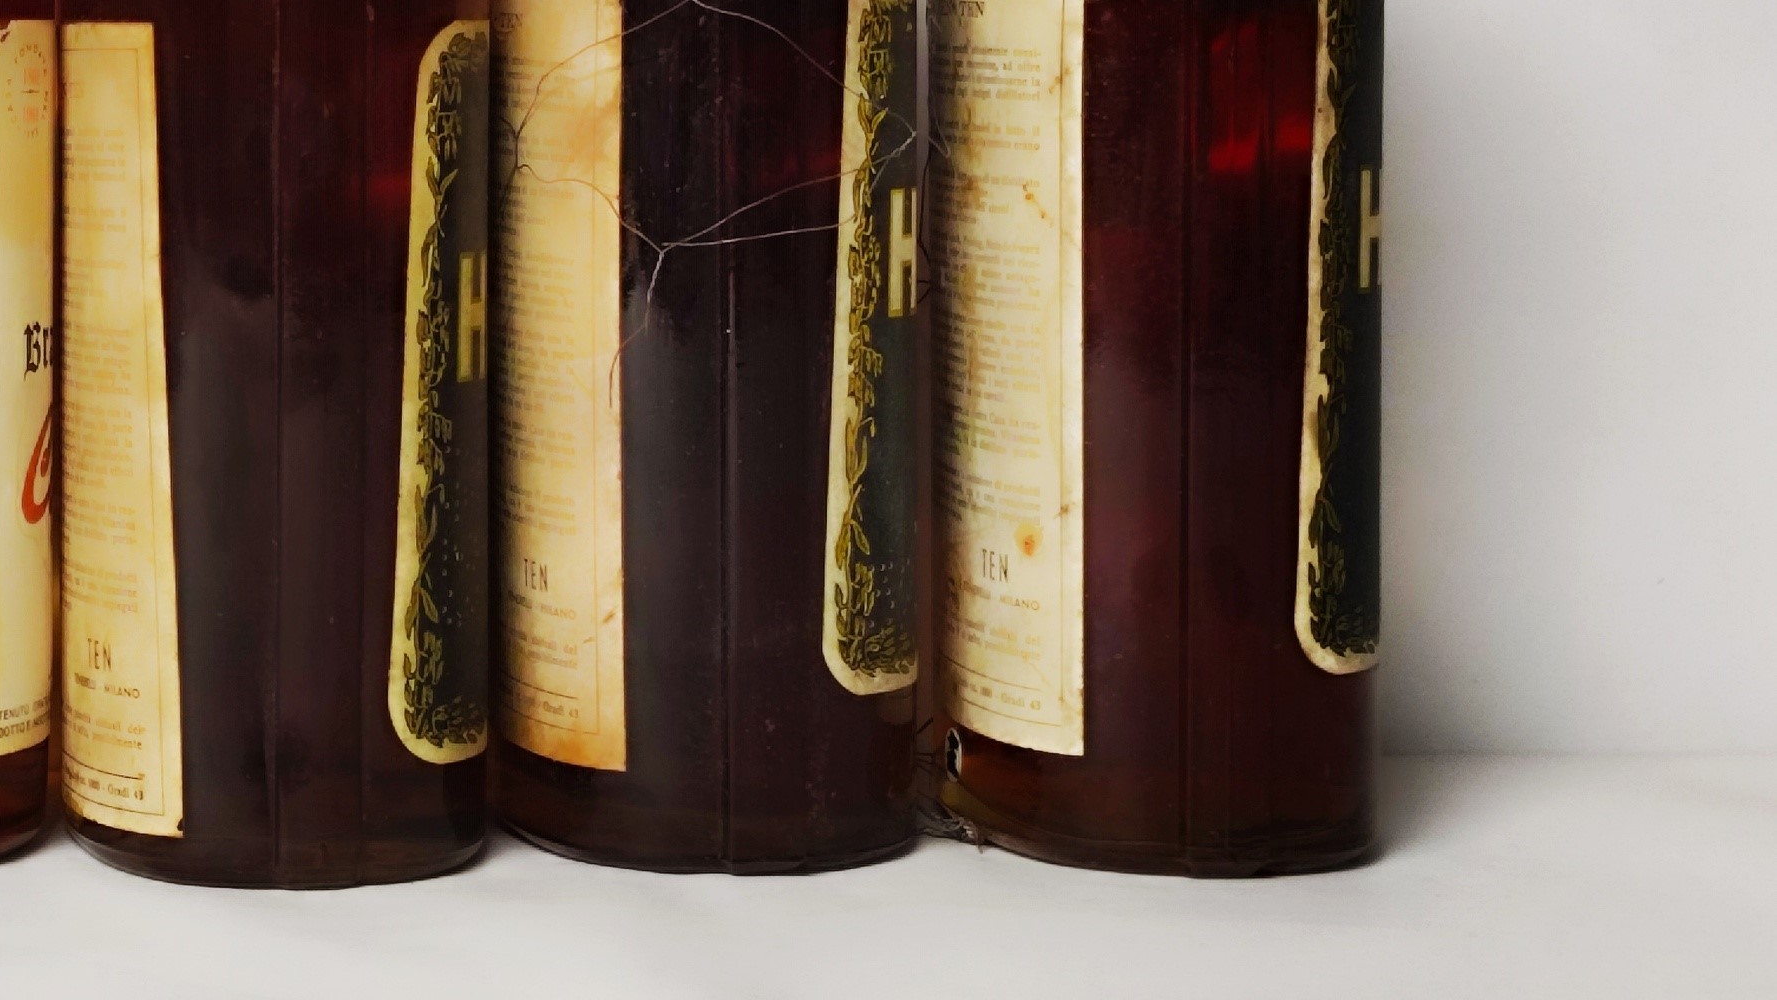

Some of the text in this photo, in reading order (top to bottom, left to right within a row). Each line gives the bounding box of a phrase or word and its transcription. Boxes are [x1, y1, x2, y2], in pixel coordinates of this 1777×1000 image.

[523, 558, 548, 592] TEN
[981, 548, 1009, 582] TEN
[87, 637, 113, 673] TEN
